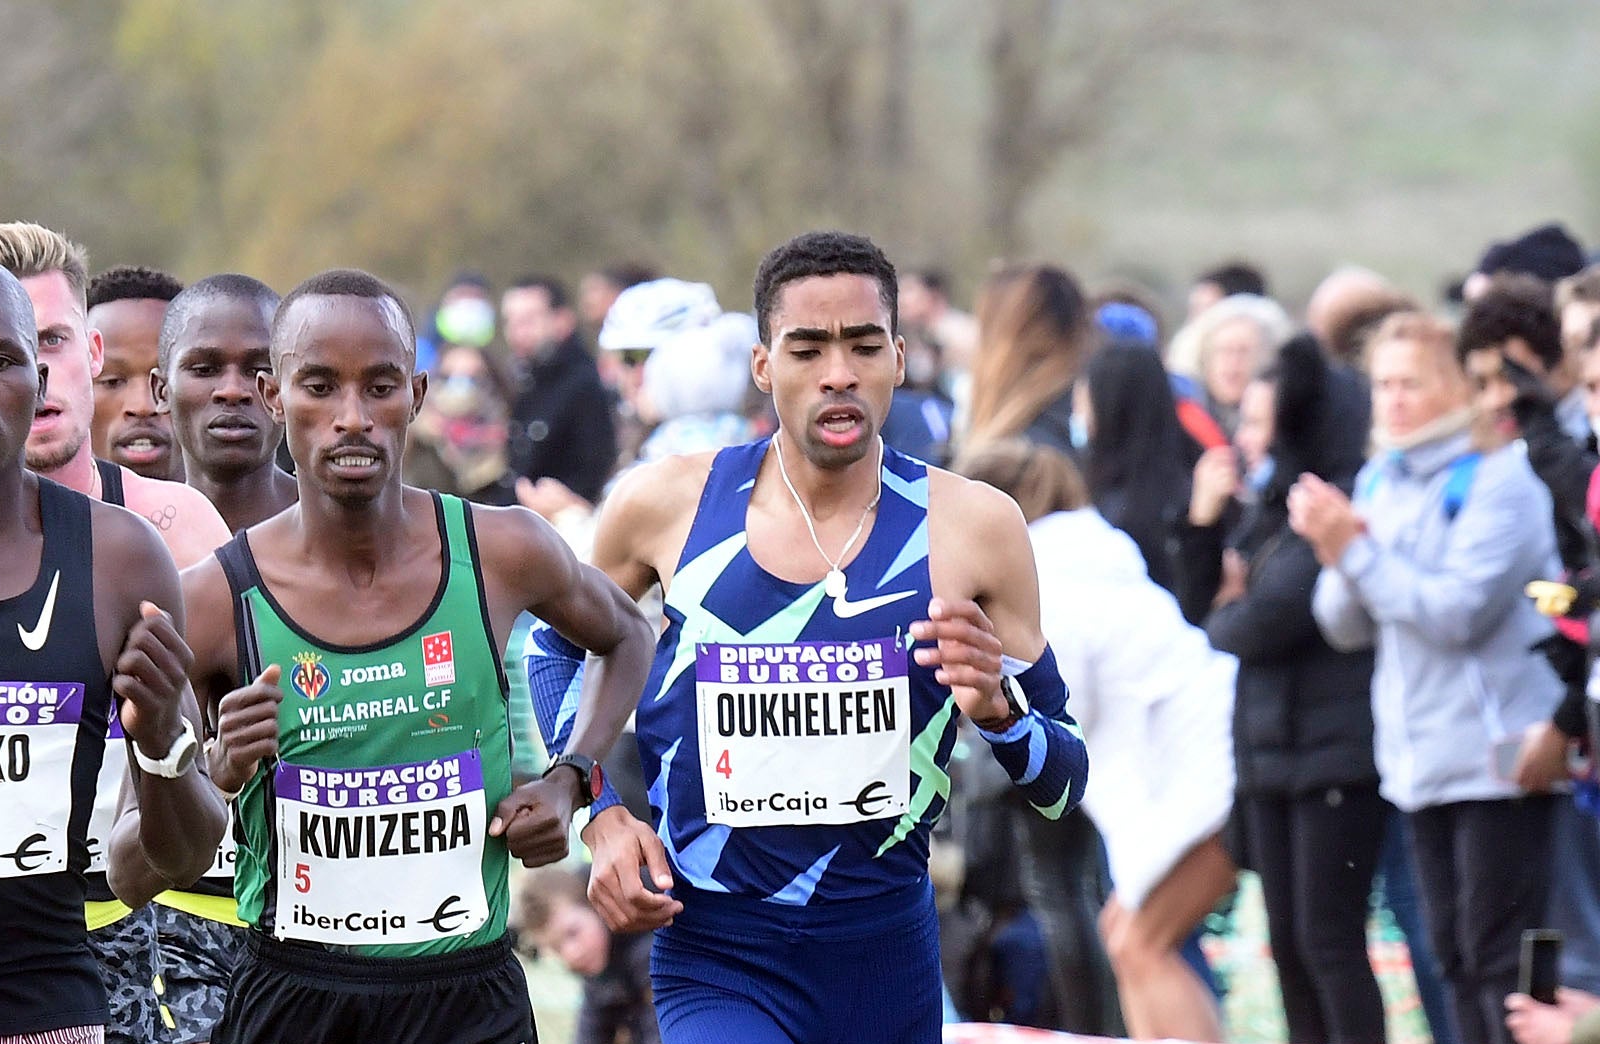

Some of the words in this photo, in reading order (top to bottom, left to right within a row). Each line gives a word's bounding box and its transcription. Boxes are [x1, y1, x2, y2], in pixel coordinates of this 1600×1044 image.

[719, 642, 883, 664] DIPUTACIÓN
[719, 662, 885, 684] BURGOS
[298, 695, 419, 725] VILLARREAL
[422, 688, 452, 710] C.F
[716, 687, 896, 737] OUKHELFEN
[300, 758, 460, 788] DIPUTACIÓN
[715, 749, 733, 779] 4
[300, 776, 462, 807] BURGOS
[718, 791, 828, 816] iberCaja
[299, 803, 471, 859] KWIZERA
[294, 863, 311, 893] 5
[293, 904, 406, 936] iberCaja
